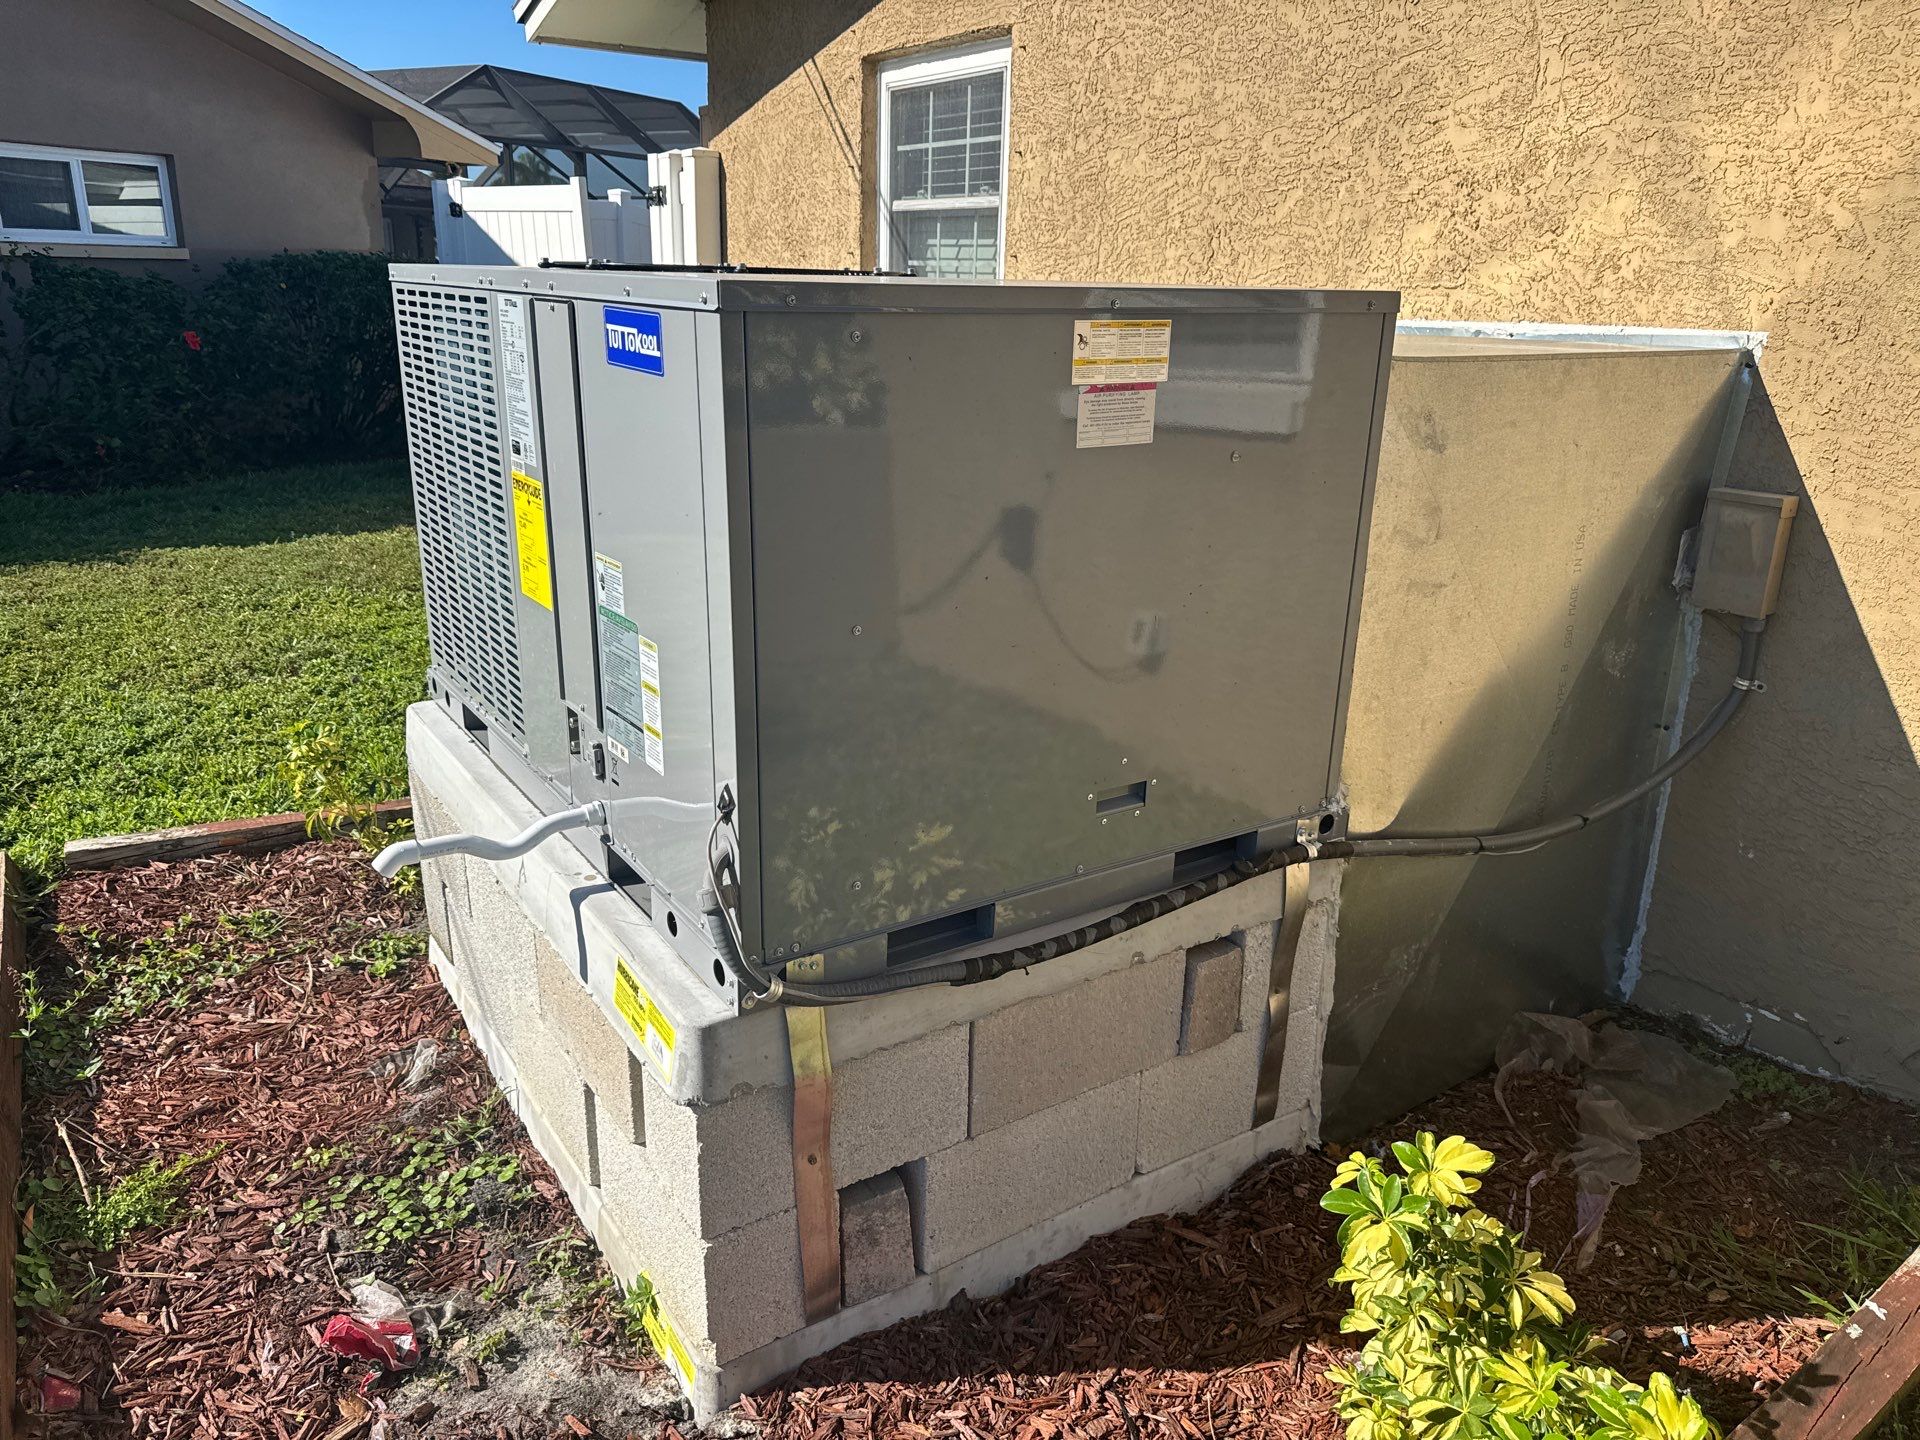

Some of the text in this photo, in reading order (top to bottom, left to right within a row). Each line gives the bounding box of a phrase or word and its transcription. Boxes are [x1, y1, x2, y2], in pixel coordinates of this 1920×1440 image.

[1576, 524, 1587, 550] USA
[1573, 557, 1582, 575] IN
[1568, 584, 1579, 617] MADE
[1561, 663, 1568, 673] B
[1555, 681, 1568, 713] TYPE
